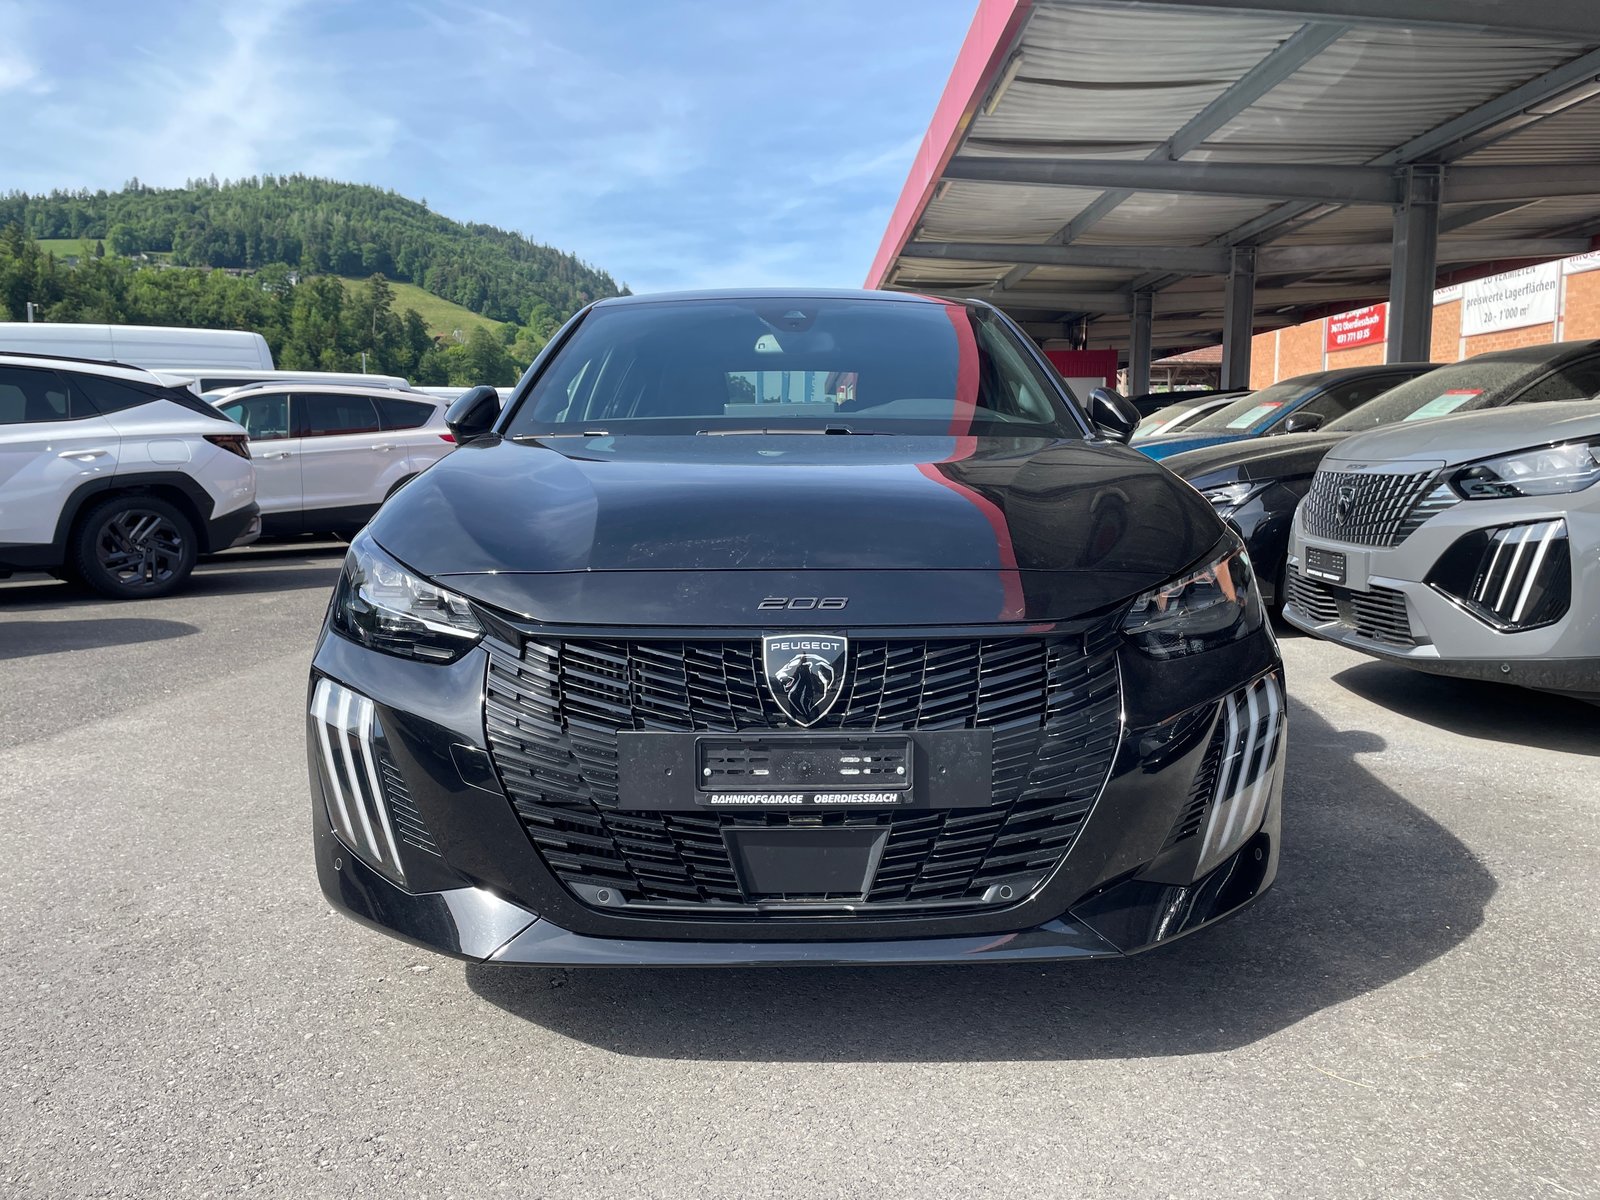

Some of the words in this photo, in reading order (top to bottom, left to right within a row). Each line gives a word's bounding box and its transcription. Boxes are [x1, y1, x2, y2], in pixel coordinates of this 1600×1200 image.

[1466, 291, 1504, 311] preiswerte
[1504, 279, 1556, 301] Lagerflächen
[1484, 312, 1493, 323] 20
[758, 597, 848, 610] 208
[771, 641, 840, 651] PEUGEOT
[711, 794, 803, 804] BAHNHOFGARAGE
[814, 793, 897, 803] OBERDIESSBACH
